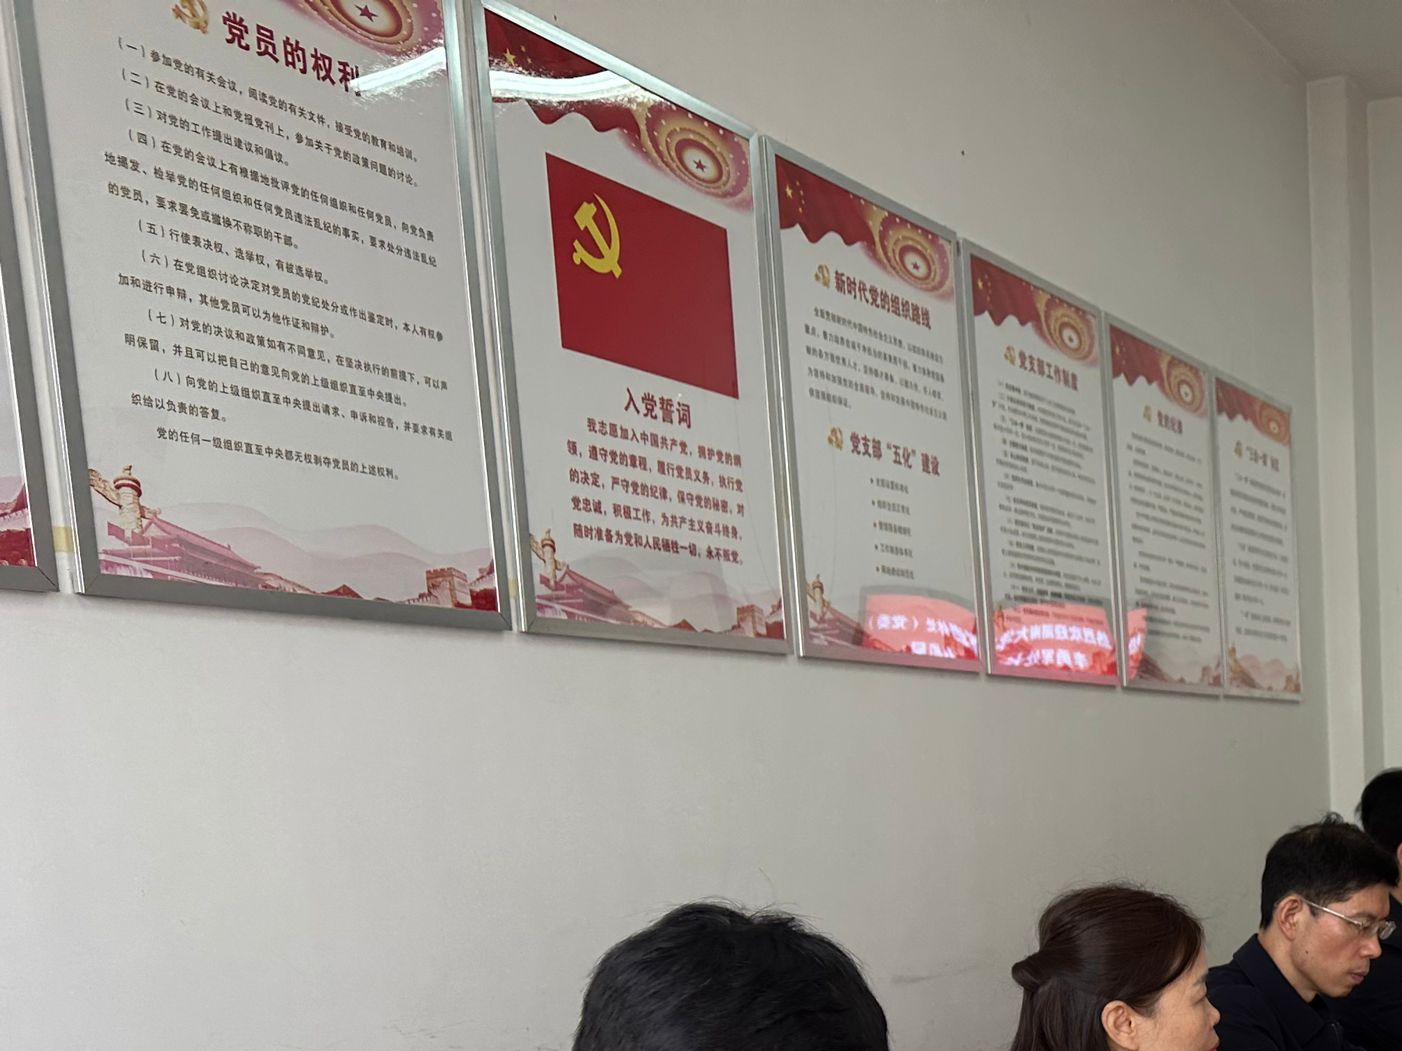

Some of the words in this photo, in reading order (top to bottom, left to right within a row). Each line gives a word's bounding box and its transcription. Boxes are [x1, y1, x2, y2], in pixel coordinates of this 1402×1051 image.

[222, 10, 361, 98] 党员的权利
[624, 387, 692, 429] 入党誓词
